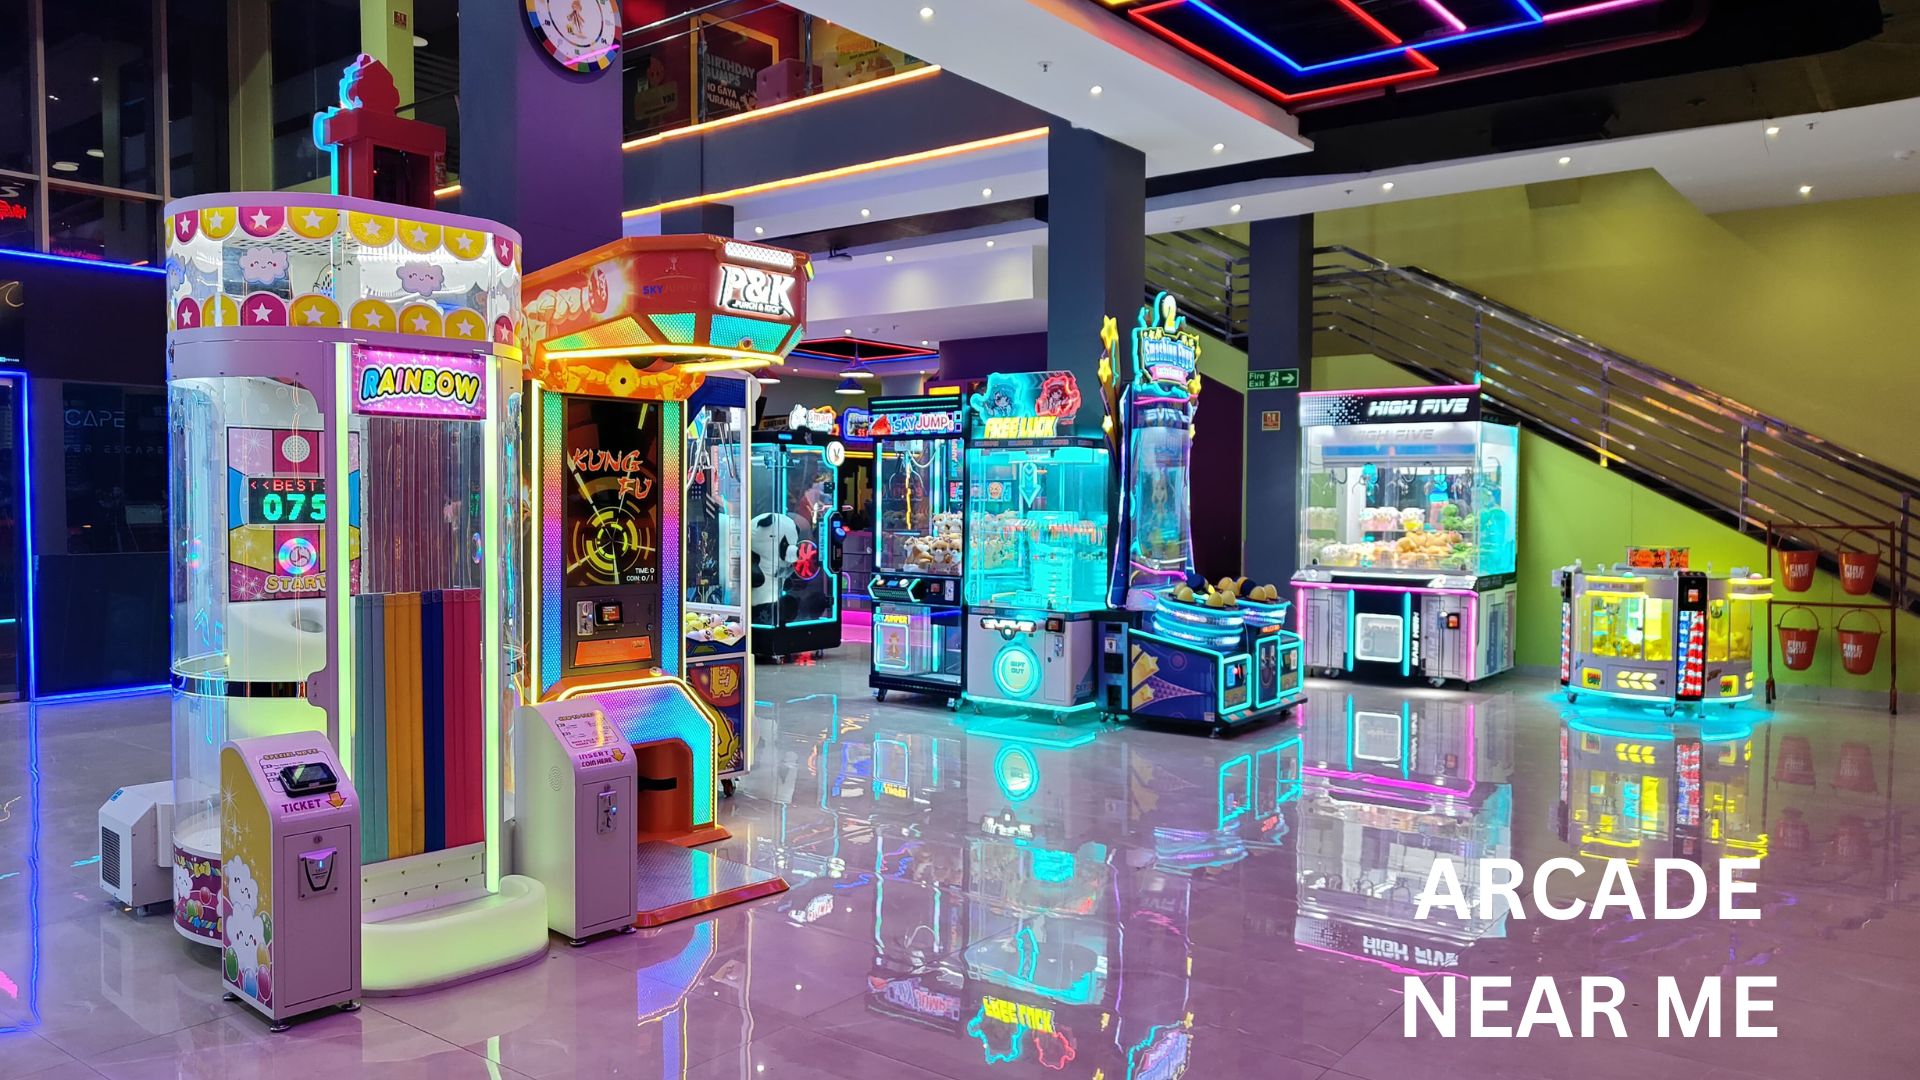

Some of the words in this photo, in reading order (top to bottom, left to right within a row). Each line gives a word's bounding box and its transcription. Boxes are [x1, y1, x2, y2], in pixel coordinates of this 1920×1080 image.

[717, 84, 737, 99] GAYA
[717, 265, 796, 317] P&K
[360, 366, 480, 405] RAINBOW
[1368, 401, 1417, 417] HIGH
[1421, 398, 1470, 414] FIVE
[984, 417, 1020, 438] FREE
[1021, 415, 1058, 438] LUCK
[573, 448, 643, 472] KUNG
[617, 477, 652, 500] FU
[579, 751, 609, 760] INSERT
[582, 760, 597, 768] COIN
[596, 757, 613, 766] HERE
[281, 798, 321, 814] TICKET
